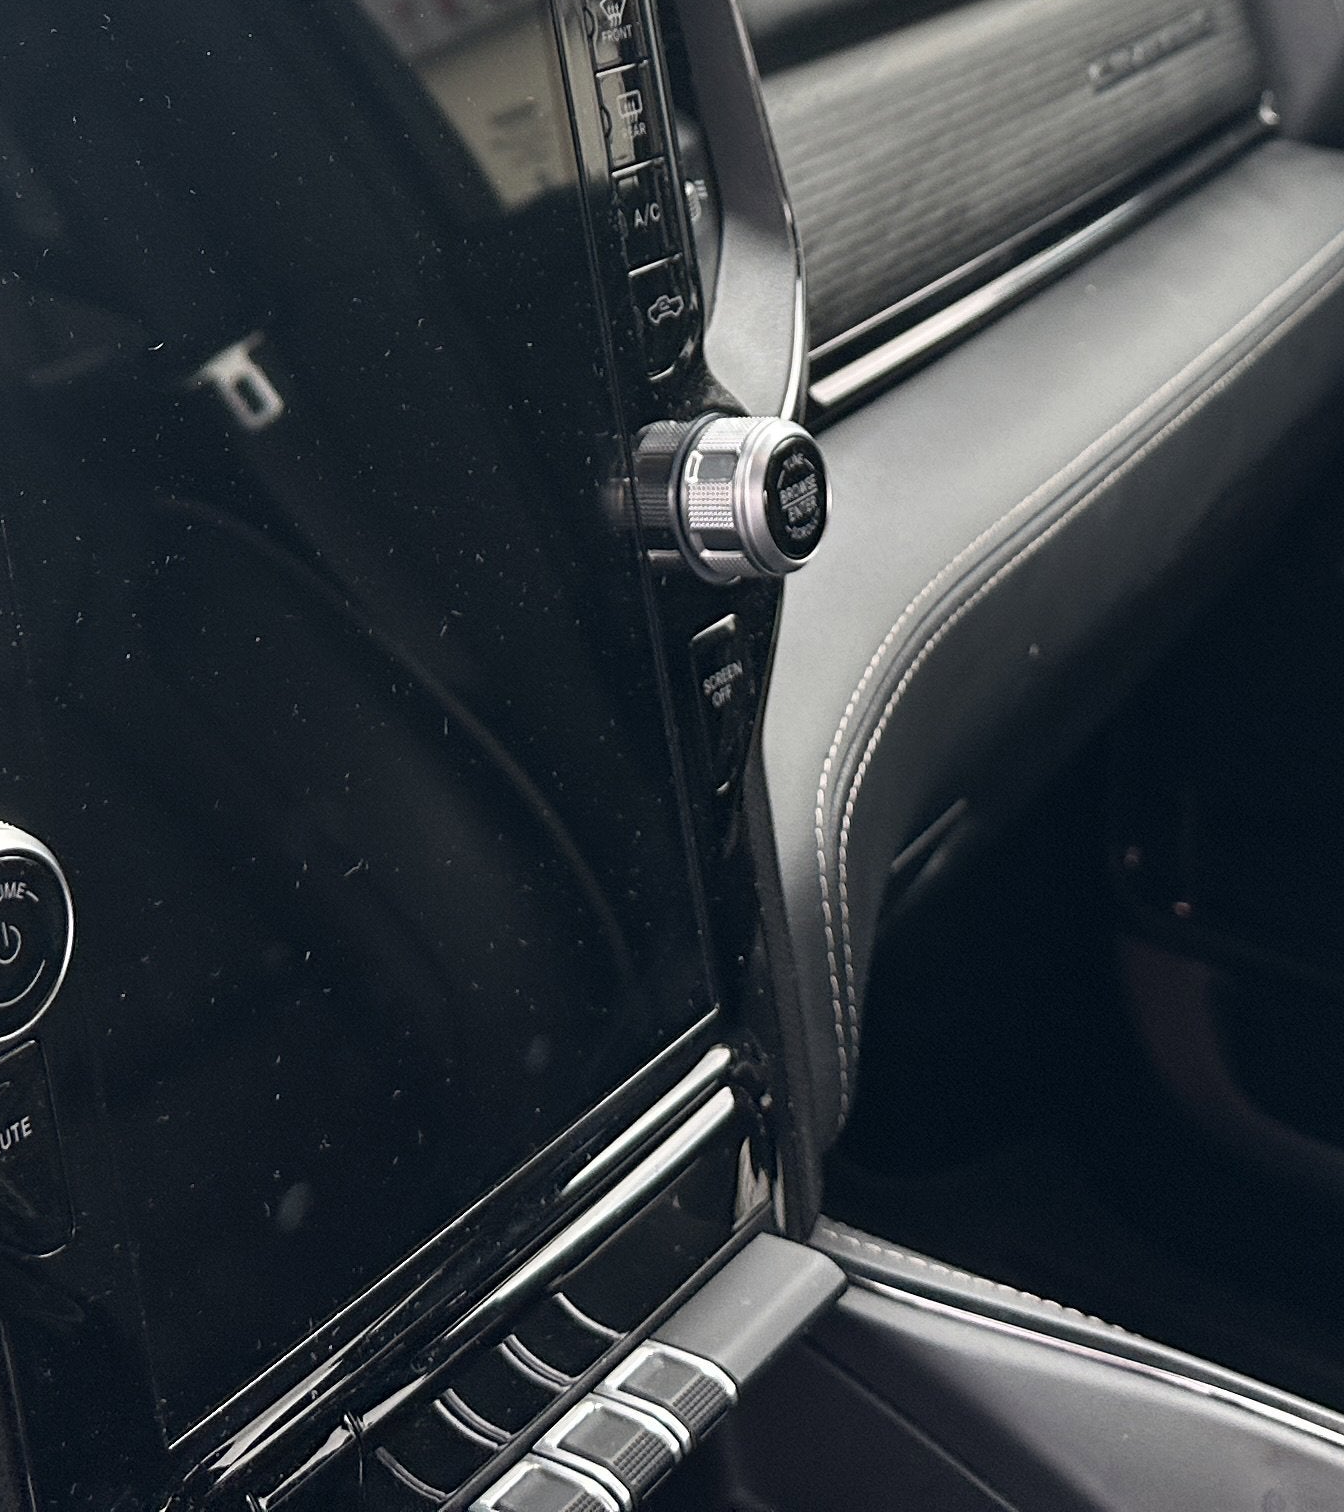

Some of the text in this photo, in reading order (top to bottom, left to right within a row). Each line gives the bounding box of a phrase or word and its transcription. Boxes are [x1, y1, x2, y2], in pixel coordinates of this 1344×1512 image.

[601, 24, 632, 41] FRONT
[623, 122, 647, 139] EAR
[634, 203, 661, 228] A/C
[703, 659, 742, 695] SCREEN
[712, 684, 732, 707] OFF
